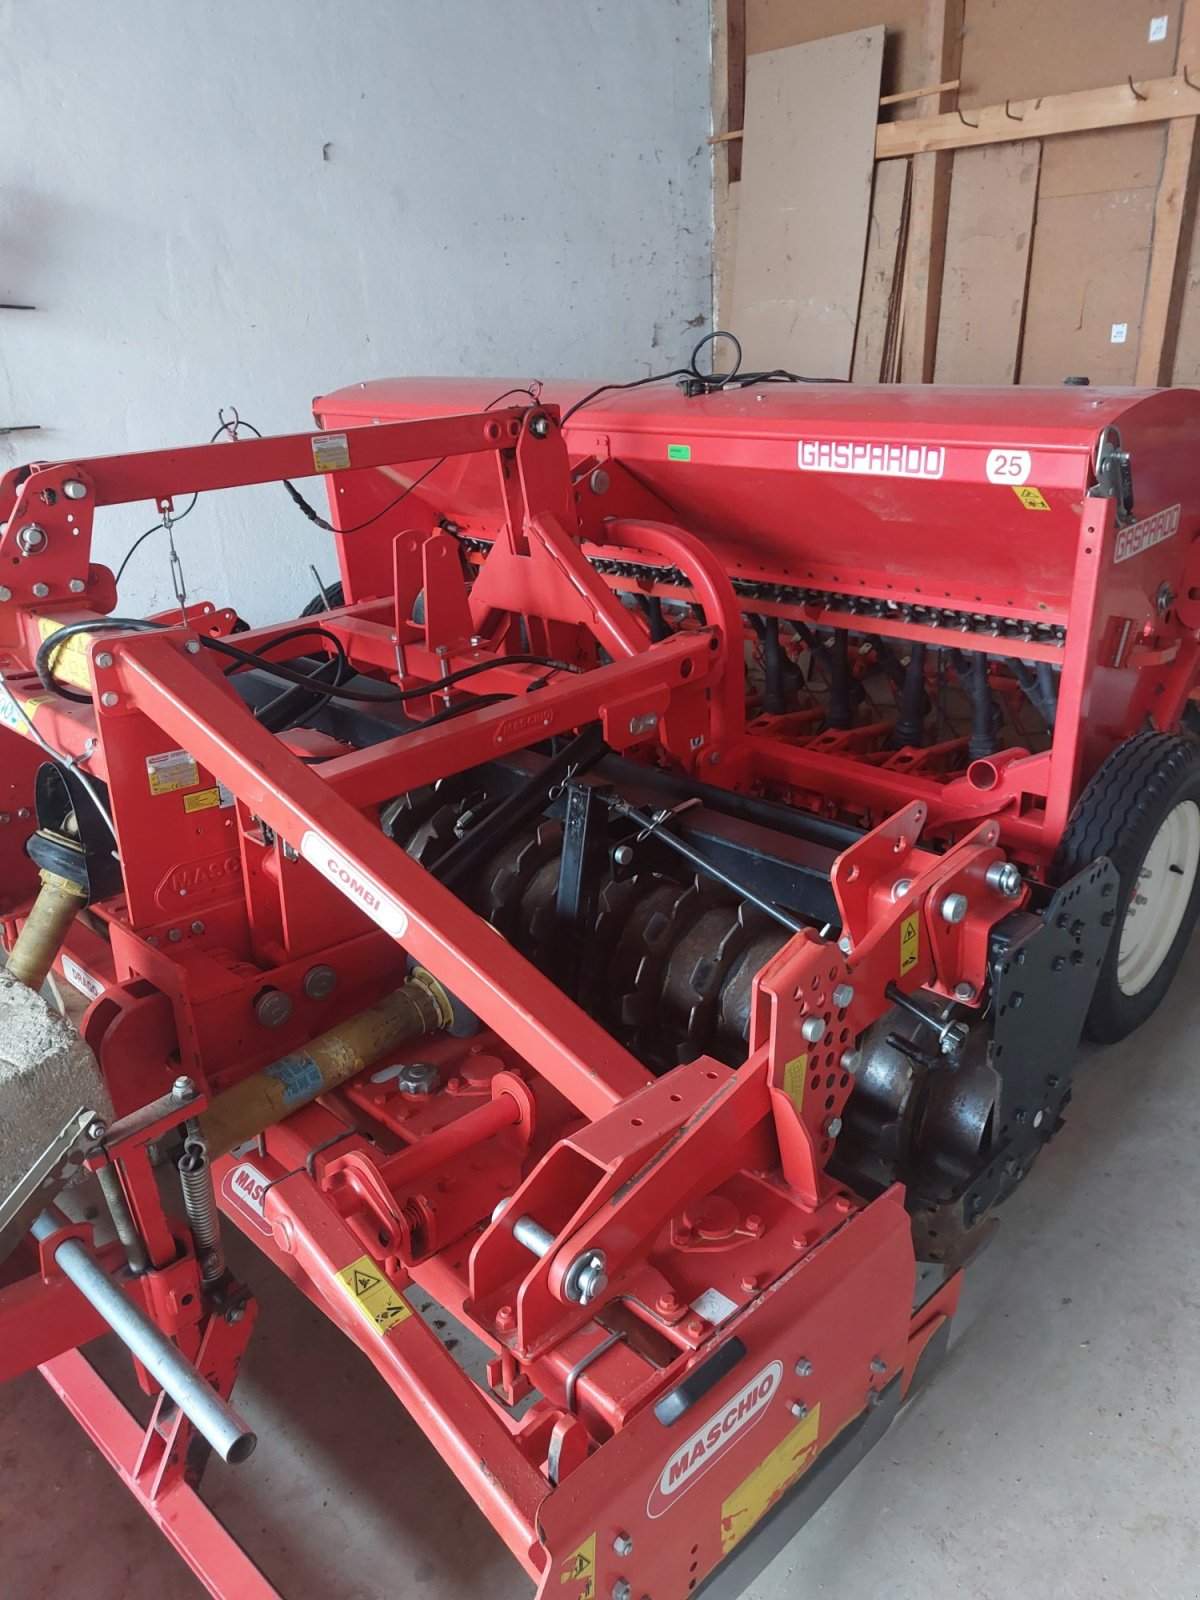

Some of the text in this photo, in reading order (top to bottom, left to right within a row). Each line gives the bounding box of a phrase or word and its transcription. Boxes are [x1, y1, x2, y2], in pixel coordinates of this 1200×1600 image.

[800, 440, 943, 476] GASPARDO
[993, 454, 1023, 476] 25
[1116, 506, 1180, 561] GASPARDO
[327, 859, 381, 911] COMBI
[668, 1374, 774, 1487] MASCHIO
